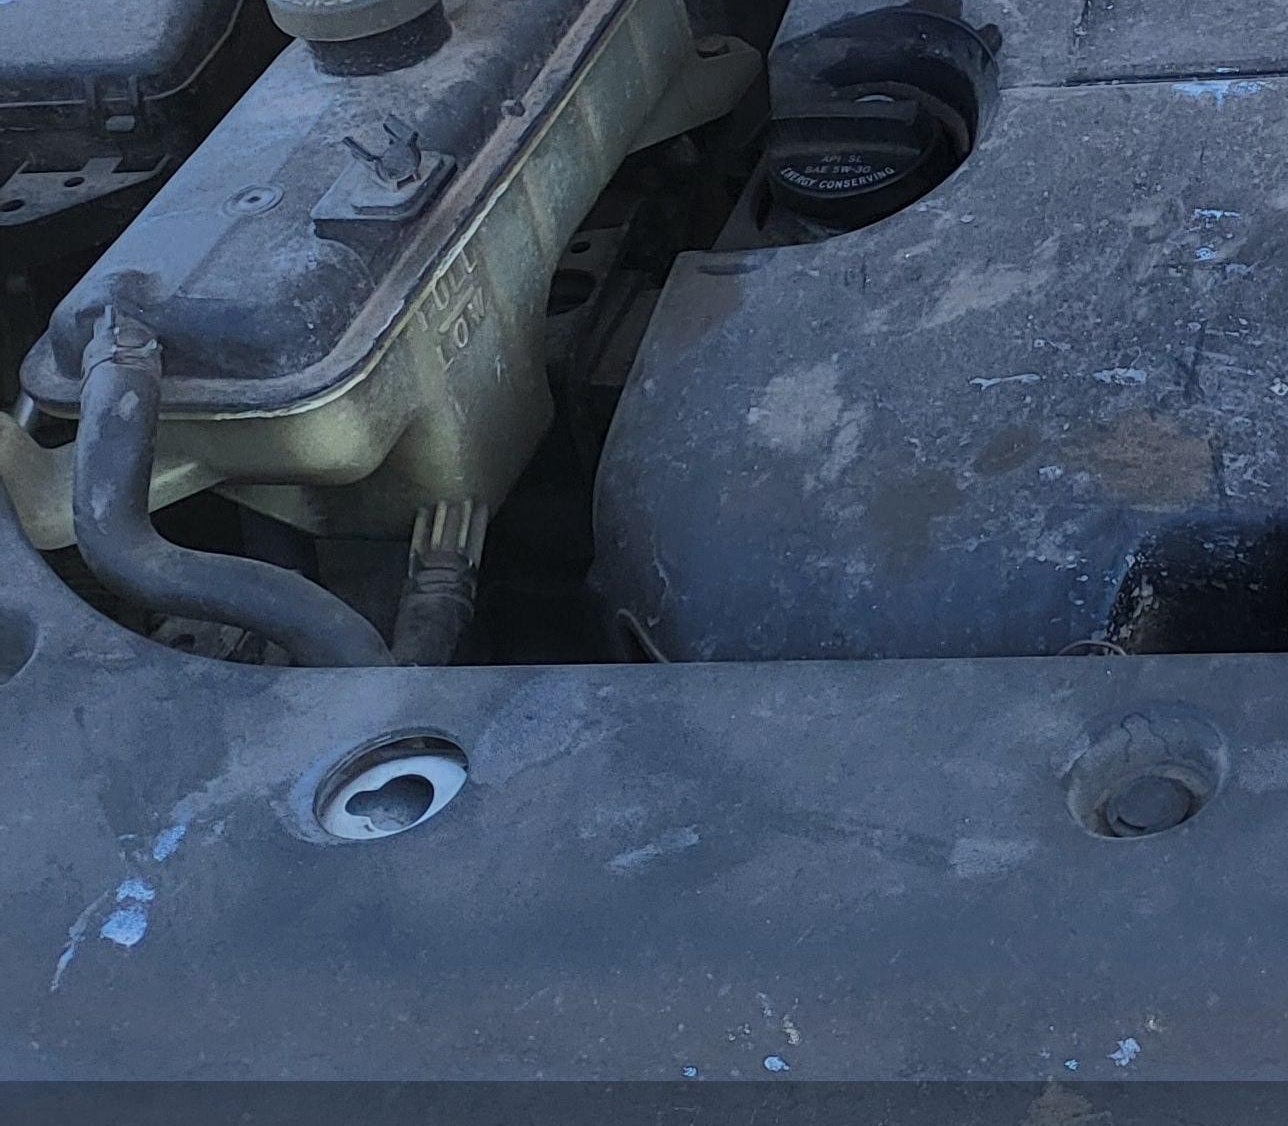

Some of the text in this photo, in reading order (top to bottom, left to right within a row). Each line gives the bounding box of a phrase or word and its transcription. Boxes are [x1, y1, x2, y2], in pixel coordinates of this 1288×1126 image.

[804, 165, 871, 174] SAE 5W-30
[780, 166, 896, 190] ENERGY CONSERVING
